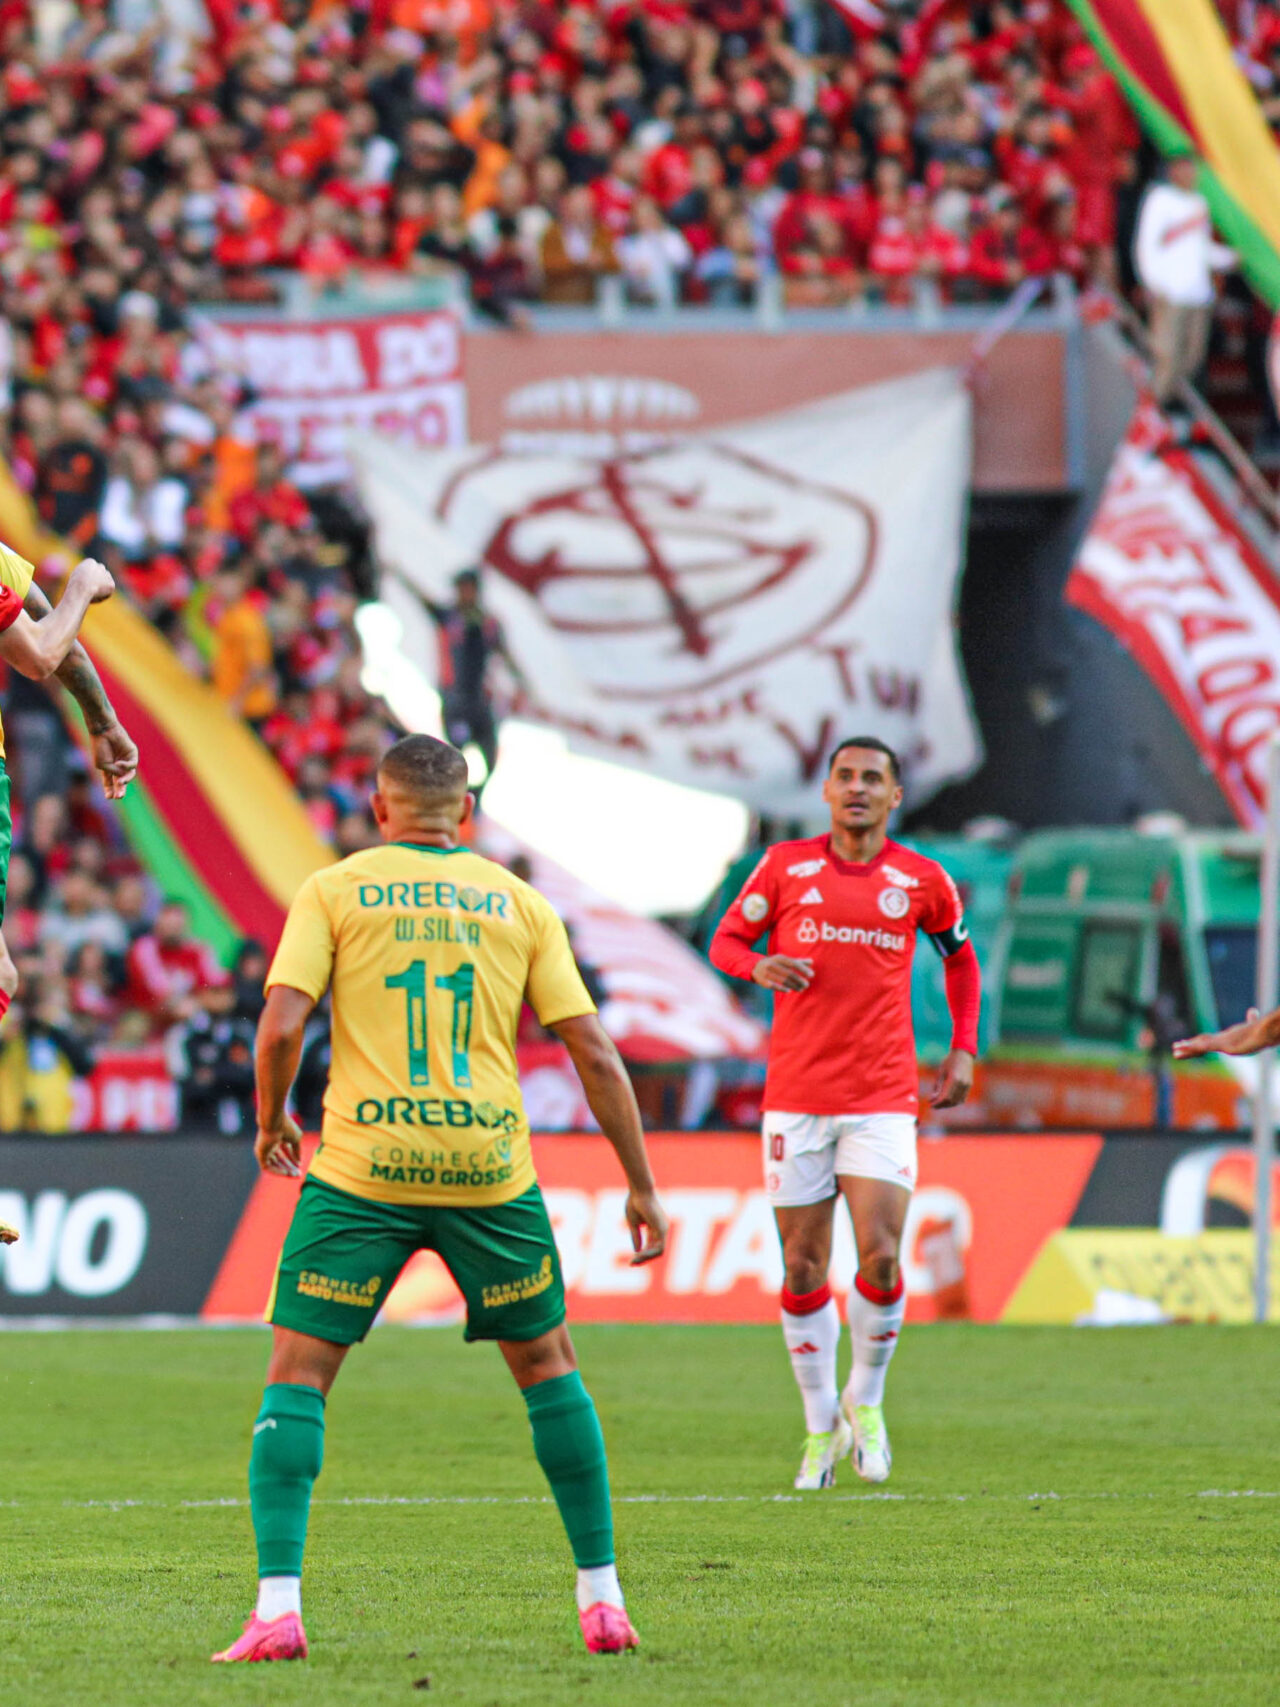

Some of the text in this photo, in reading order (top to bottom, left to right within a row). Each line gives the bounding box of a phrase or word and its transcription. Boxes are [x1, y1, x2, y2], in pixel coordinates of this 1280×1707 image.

[359, 882, 508, 918] DREBOR
[821, 922, 906, 951] banrisul
[384, 959, 475, 1089] 11
[356, 1097, 519, 1134] DREBOR
[369, 1163, 436, 1184] MATO
[371, 1145, 497, 1172] CONHEÇA
